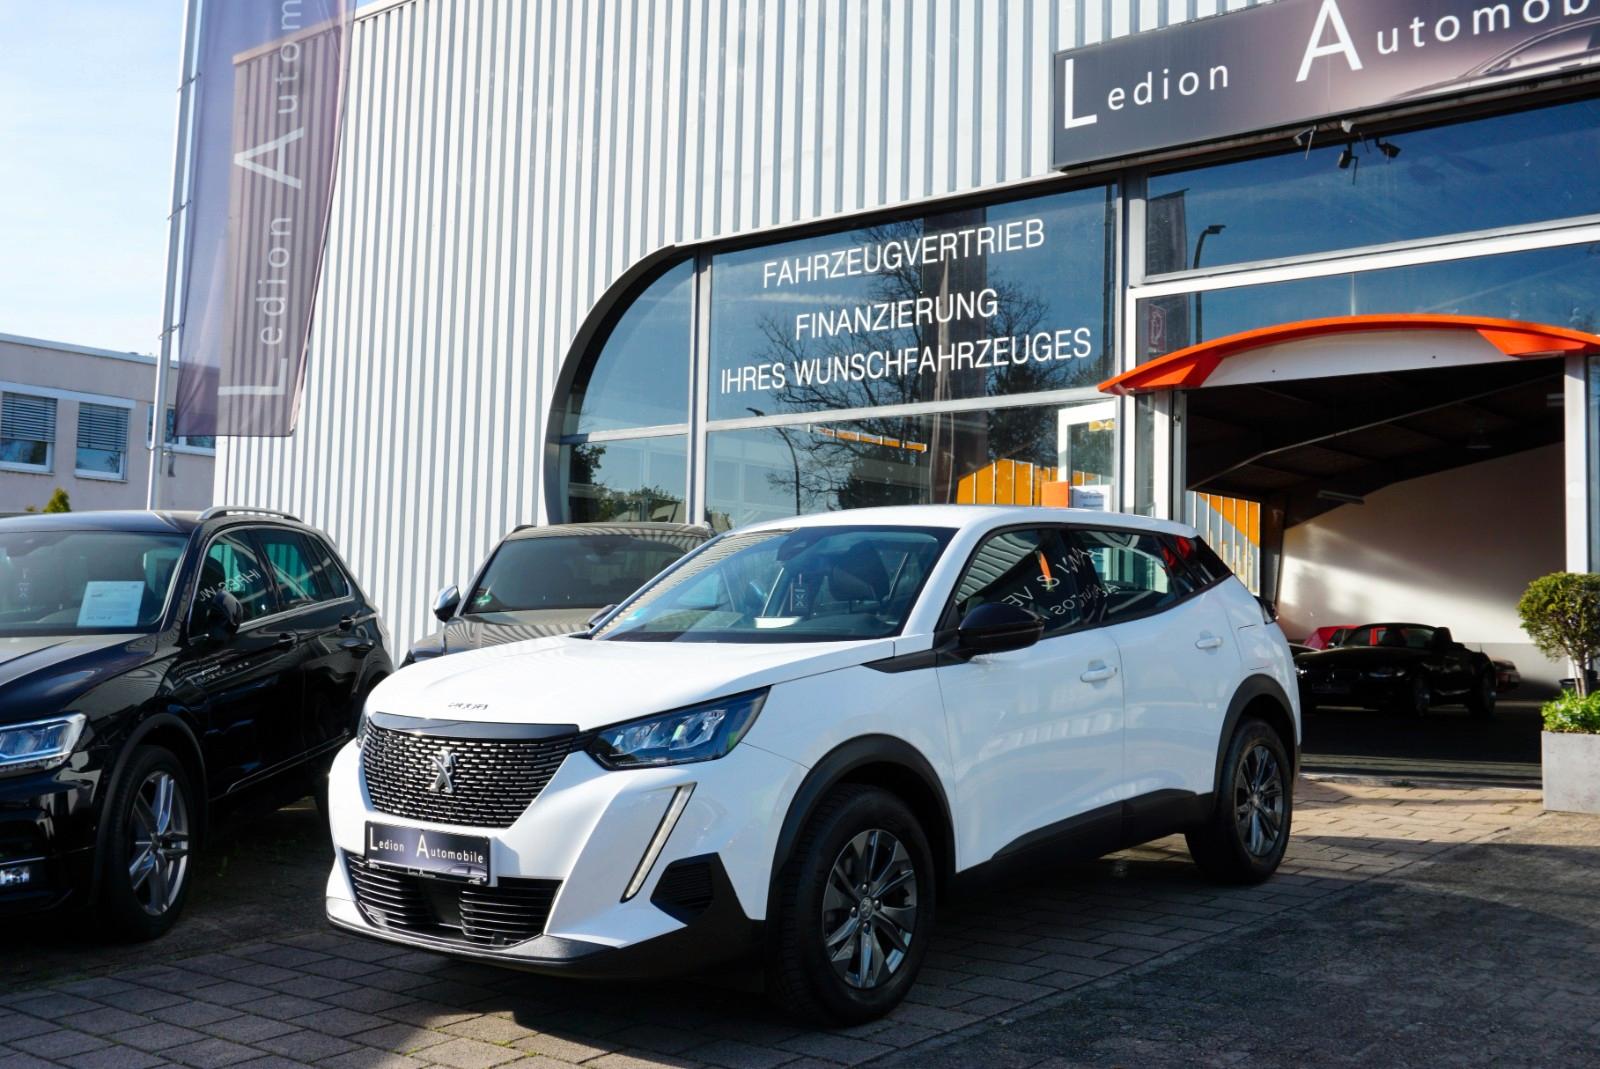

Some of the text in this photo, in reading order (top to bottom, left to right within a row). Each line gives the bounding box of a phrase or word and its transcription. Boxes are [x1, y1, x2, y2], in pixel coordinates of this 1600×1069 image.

[1064, 59, 1229, 130] Ledion
[763, 218, 1045, 289] FAHRZEUGVERTRIEB
[218, 216, 292, 397] Ledion
[795, 289, 999, 341] FINANZIERUNG
[721, 327, 1092, 394] IHRES WUNSCHFAHRZEUGES
[370, 827, 484, 864] Ledion Automobile
